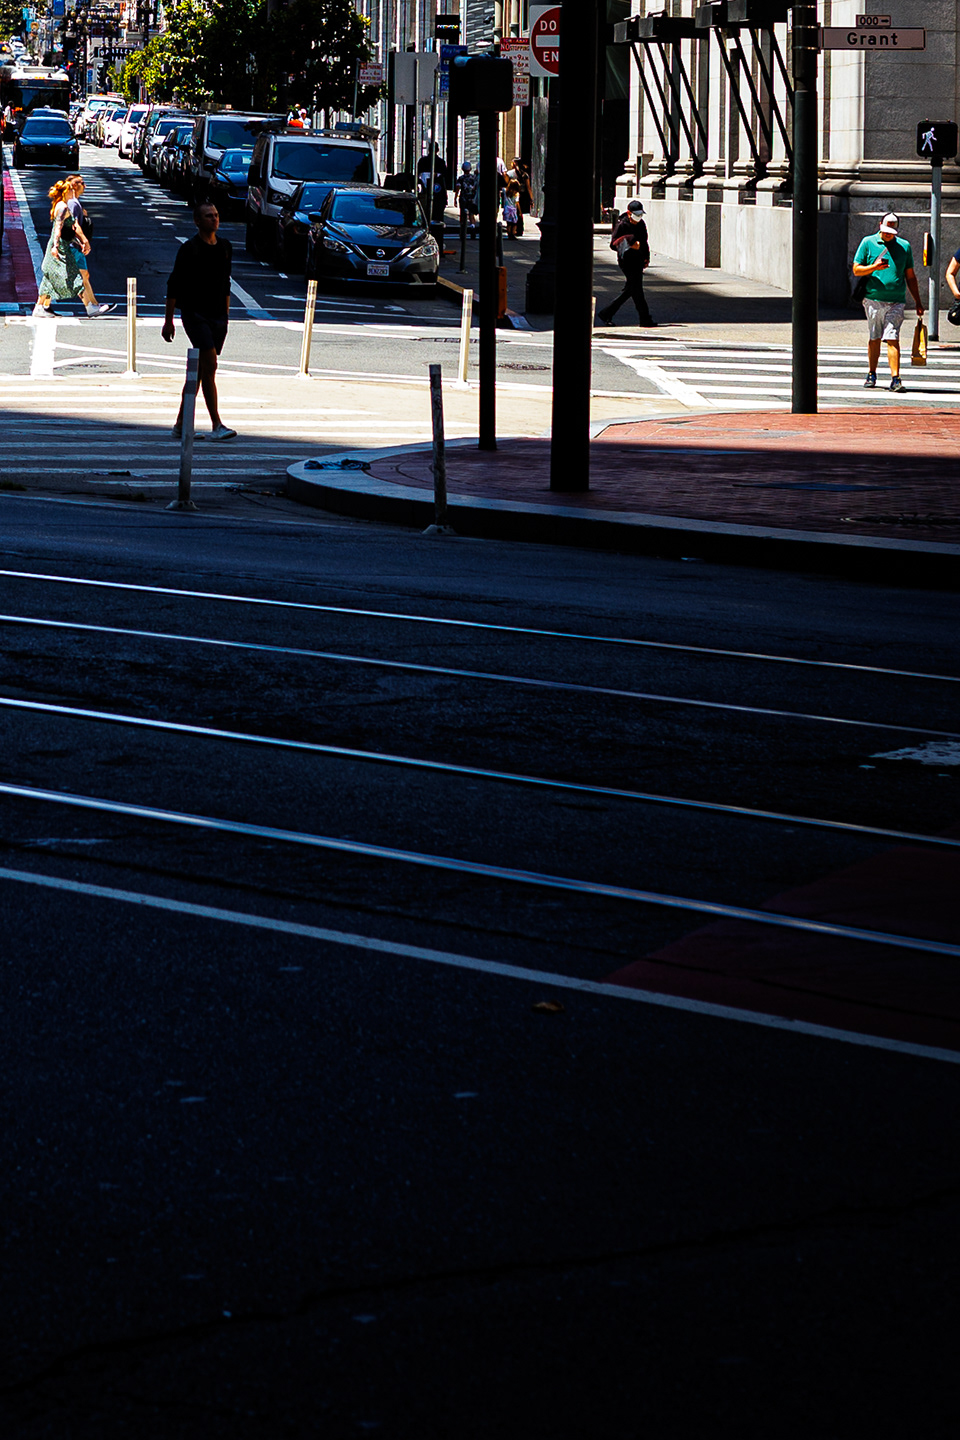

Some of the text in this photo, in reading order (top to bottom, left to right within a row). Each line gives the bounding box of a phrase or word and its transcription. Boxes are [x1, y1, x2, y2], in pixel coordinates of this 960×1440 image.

[540, 20, 557, 31] DO
[859, 16, 879, 25] 000
[847, 32, 898, 45] Grant
